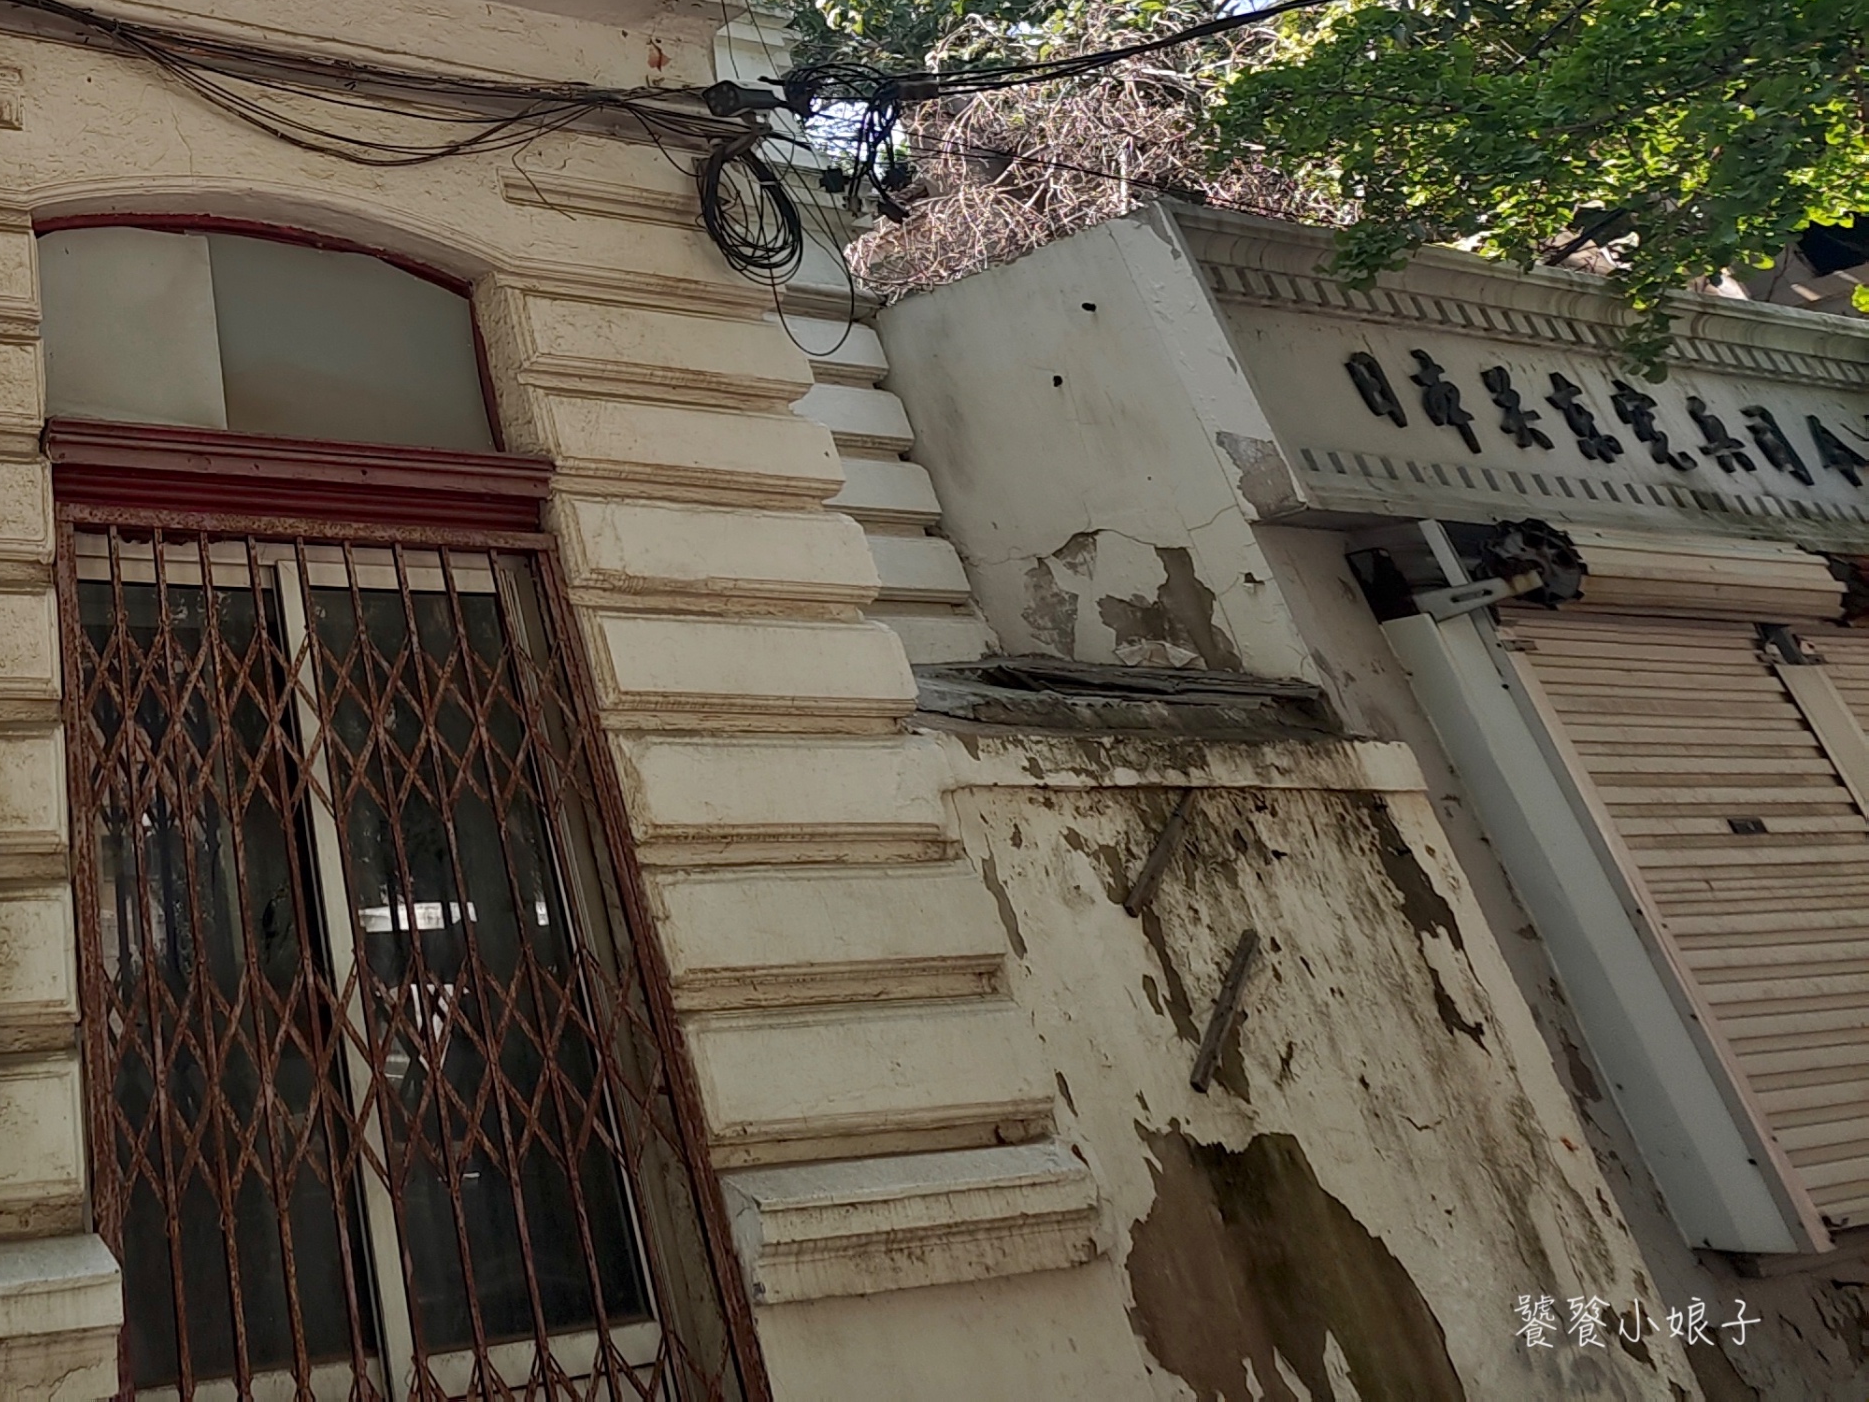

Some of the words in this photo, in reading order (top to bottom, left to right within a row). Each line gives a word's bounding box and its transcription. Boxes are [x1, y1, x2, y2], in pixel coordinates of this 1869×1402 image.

[1344, 348, 1869, 487] 日本关东宪兵司令
